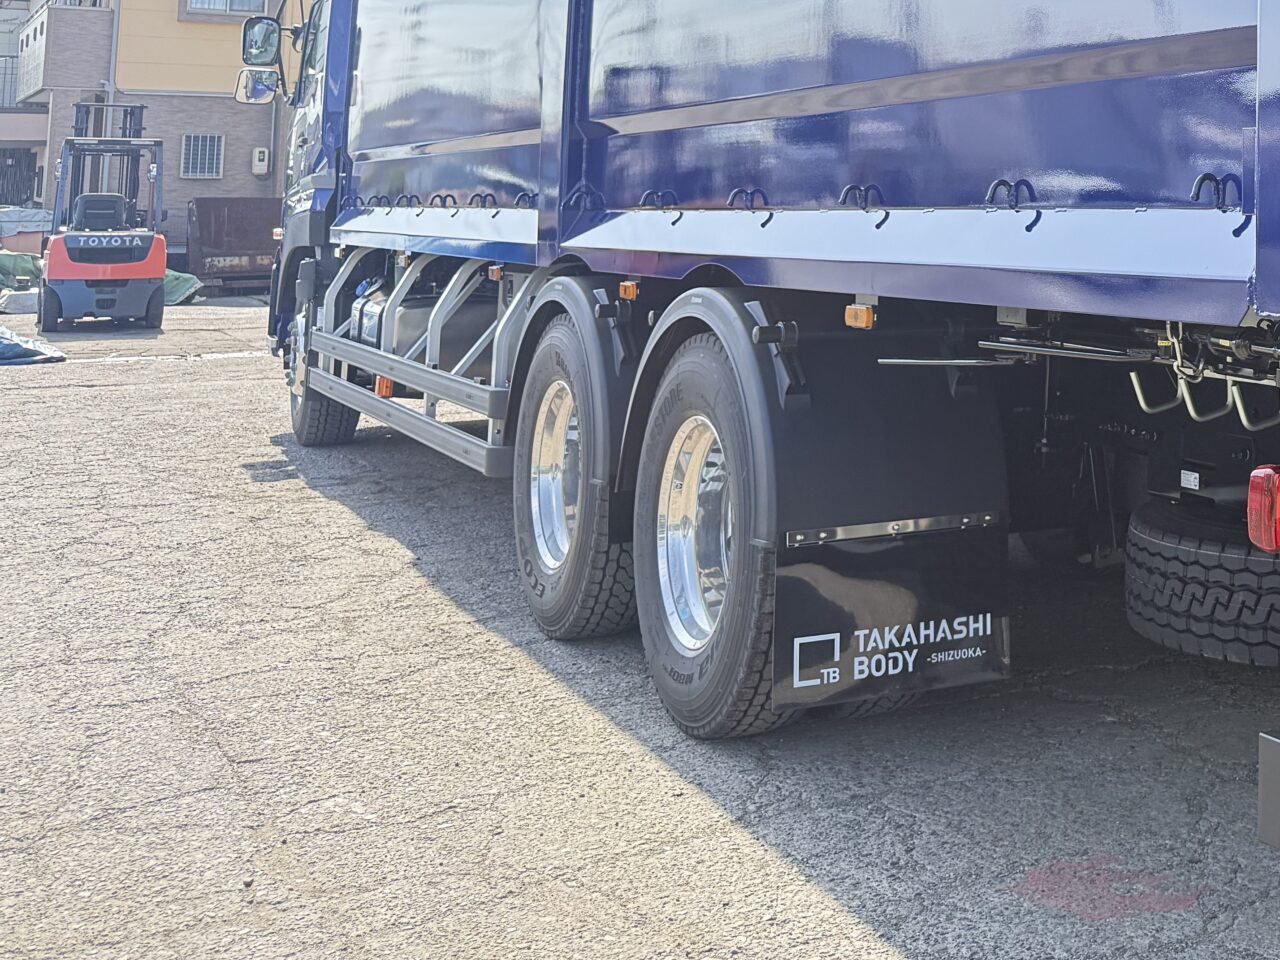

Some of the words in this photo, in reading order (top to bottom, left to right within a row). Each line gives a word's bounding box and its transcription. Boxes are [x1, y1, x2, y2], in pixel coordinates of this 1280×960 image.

[79, 236, 142, 246] TOYOTA
[854, 613, 991, 653] TAKAHASHI
[820, 667, 840, 684] TB
[854, 649, 918, 680] BODY
